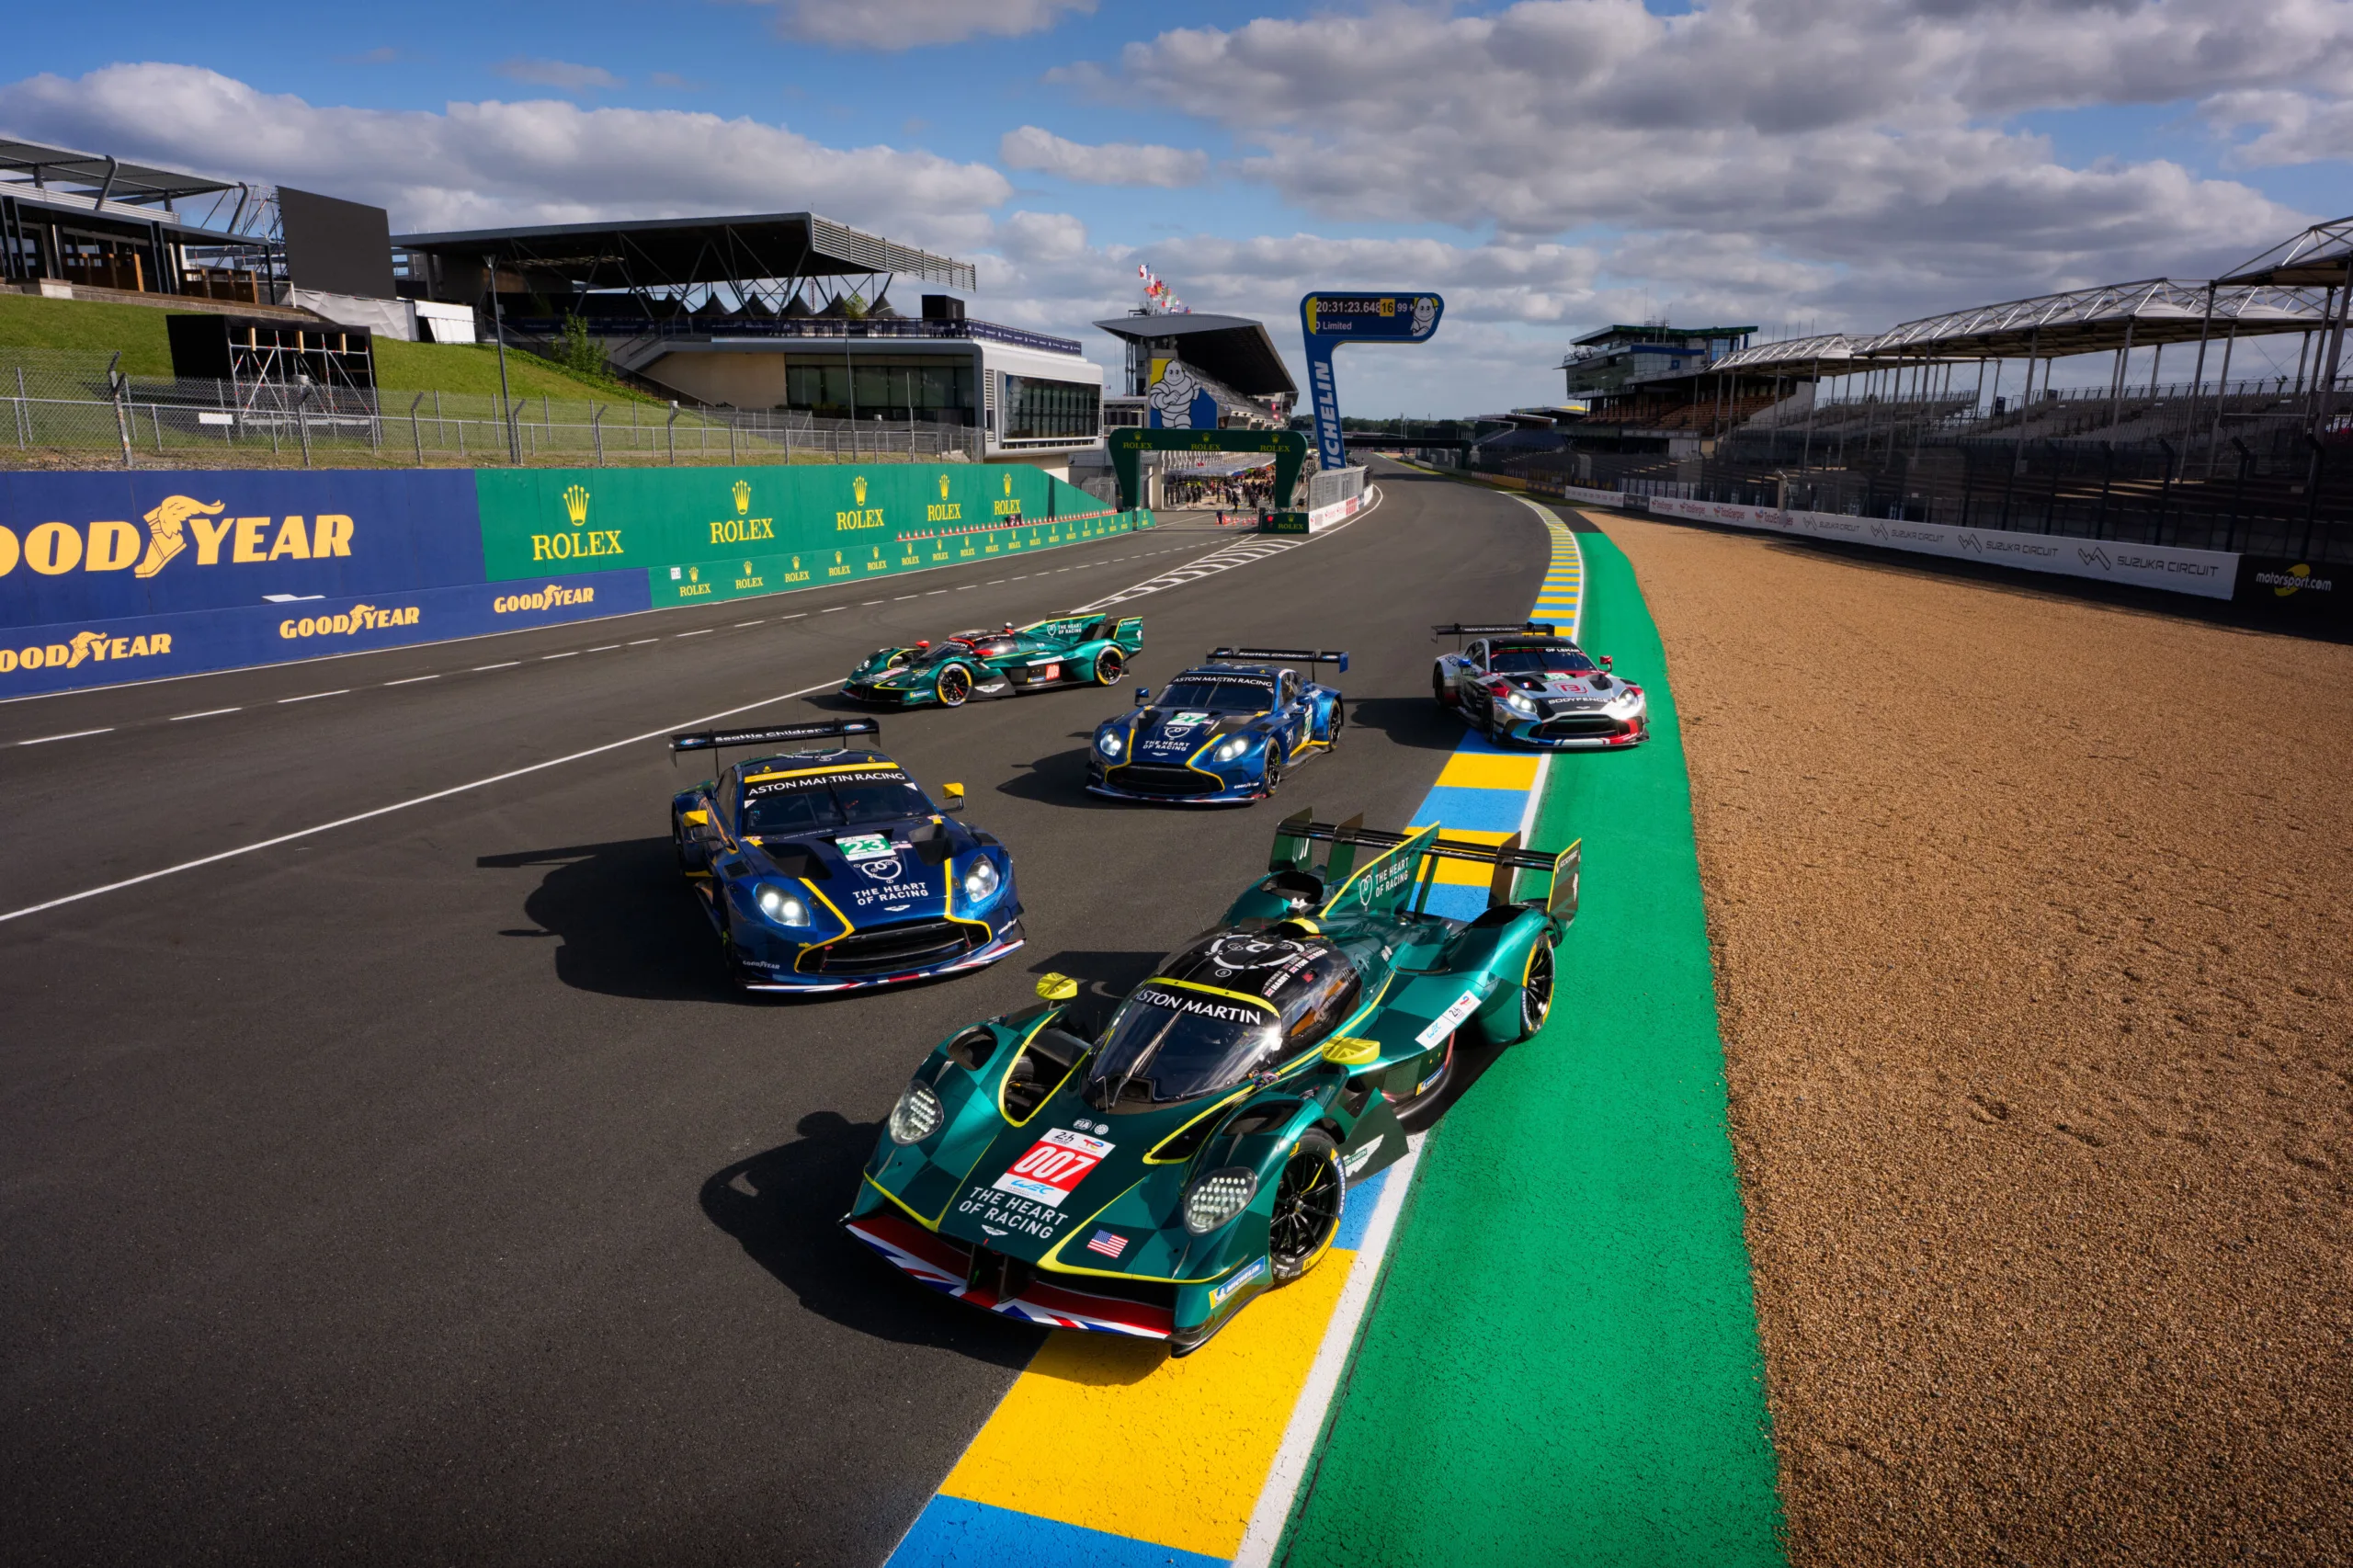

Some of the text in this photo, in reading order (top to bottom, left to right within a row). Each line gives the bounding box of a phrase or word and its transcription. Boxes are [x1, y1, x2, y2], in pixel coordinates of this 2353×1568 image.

[1381, 301, 1393, 313] 16
[1397, 303, 1407, 312] 99
[1323, 322, 1352, 331] Limited
[927, 503, 961, 521] ROLEX
[994, 499, 1021, 516] ROLEX
[1721, 507, 1745, 521] TotalEnergies
[836, 508, 884, 530] ROLEX
[1819, 520, 1861, 532] SUZUKA CIRCUIT
[710, 517, 775, 544] ROLEX
[1892, 529, 1945, 543] SUZUKA CIRCUIT
[531, 530, 624, 562] ROLEX
[961, 548, 975, 557] ROLEX
[1985, 540, 2059, 558] SUZUKA CIRCUIT
[902, 556, 919, 565] ROLEX
[933, 552, 949, 561] ROLEX
[829, 565, 851, 576] ROLEX
[867, 561, 887, 571] ROLEX
[2118, 555, 2219, 577] SUZUKA CIRCUIT
[735, 577, 763, 589] ROLEX
[785, 571, 810, 583] ROLEX
[2256, 572, 2332, 592] motorsport.com
[679, 584, 711, 597] ROLEX
[494, 585, 595, 614] GOODYEAR
[279, 607, 420, 639] GOODYEAR
[1238, 678, 1273, 687] RACING
[1548, 697, 1609, 705] BODYFENCE
[715, 733, 764, 742] Seattle
[748, 781, 797, 797] ASTON
[800, 774, 852, 788] MARTIN
[854, 772, 905, 781] RACING
[845, 840, 886, 855] 23
[1375, 857, 1409, 884] THE HEART
[853, 882, 926, 899] THE HEART
[1375, 870, 1408, 897] OF RACING
[858, 890, 928, 905] OF RACING
[1270, 972, 1290, 991] HARRY
[1182, 1000, 1261, 1025] MARTIN
[1074, 1119, 1090, 1130] FIA
[1352, 1149, 1367, 1162] MARTIN
[1014, 1145, 1097, 1183] 007
[1011, 1179, 1056, 1195] WEC
[1337, 1165, 1347, 1215] MICHELIN
[970, 1187, 1006, 1205] THE
[1006, 1197, 1068, 1226] HEART
[959, 1200, 1053, 1239] OF RACING
[1227, 1264, 1260, 1293] MICHELIN
